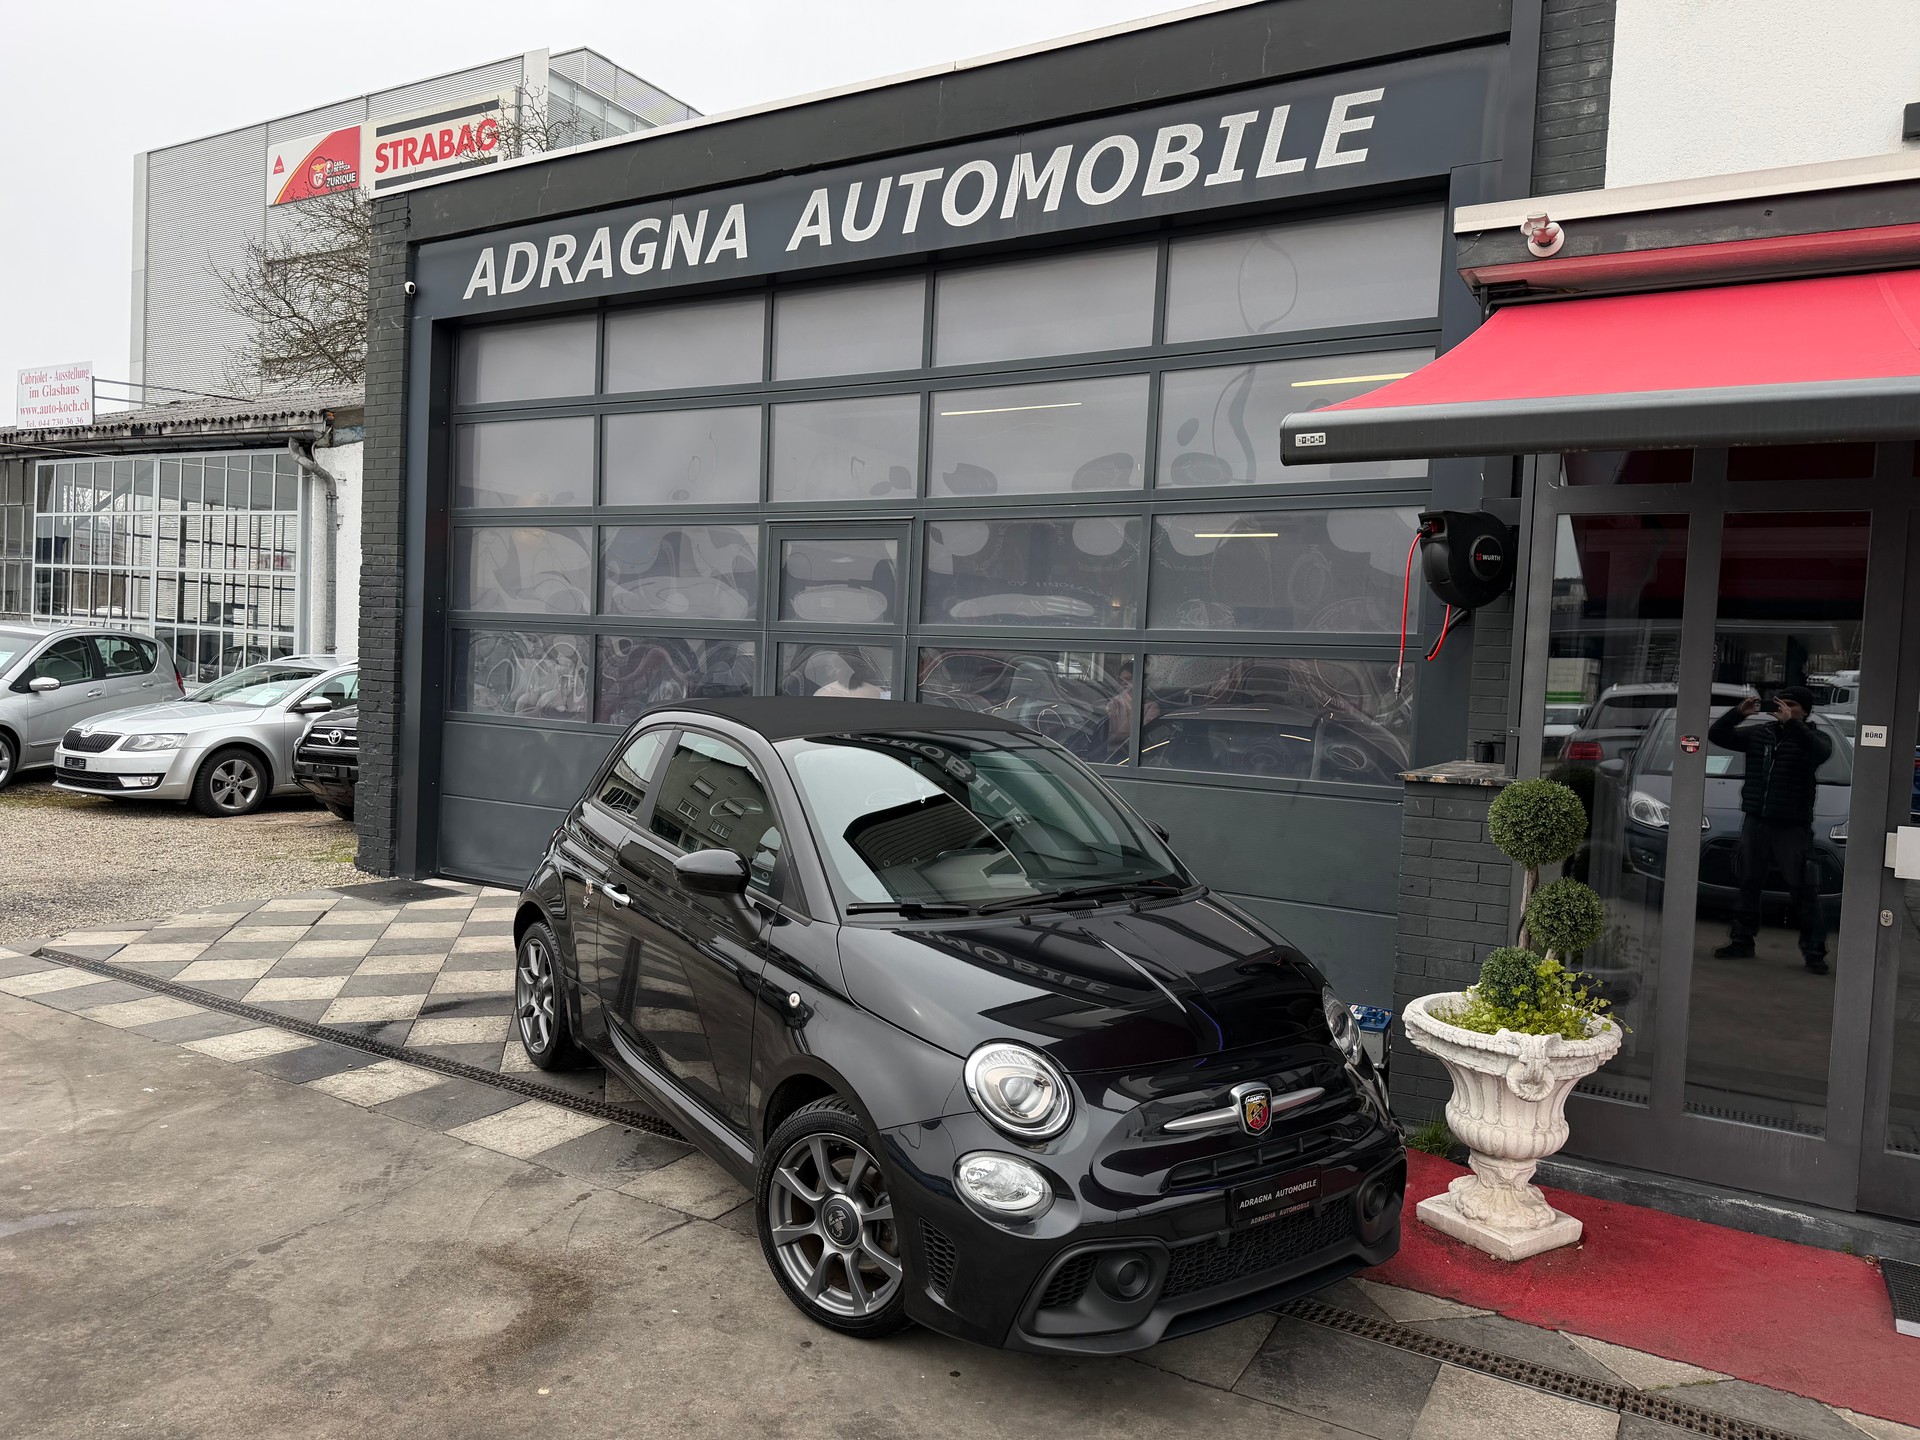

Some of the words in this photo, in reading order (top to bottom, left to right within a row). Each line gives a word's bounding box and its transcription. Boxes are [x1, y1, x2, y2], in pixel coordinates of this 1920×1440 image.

[375, 118, 498, 173] STRABAG
[326, 172, 356, 187] ZURIQUE
[462, 203, 750, 300] ADRAGNA
[786, 87, 1385, 252] AUTOMOBILE
[20, 372, 48, 385] Cabriolet
[54, 367, 90, 382] Ausstellung
[29, 387, 39, 398] im
[42, 384, 80, 398] Glashaus
[20, 398, 90, 415] www.auto-koch.ch
[1239, 1193, 1273, 1209] ADRAGNA
[1275, 1179, 1317, 1198] AUTOMOBILE
[1250, 1212, 1276, 1225] ADRAGNA
[1279, 1201, 1310, 1216] AUTOMOBILE
